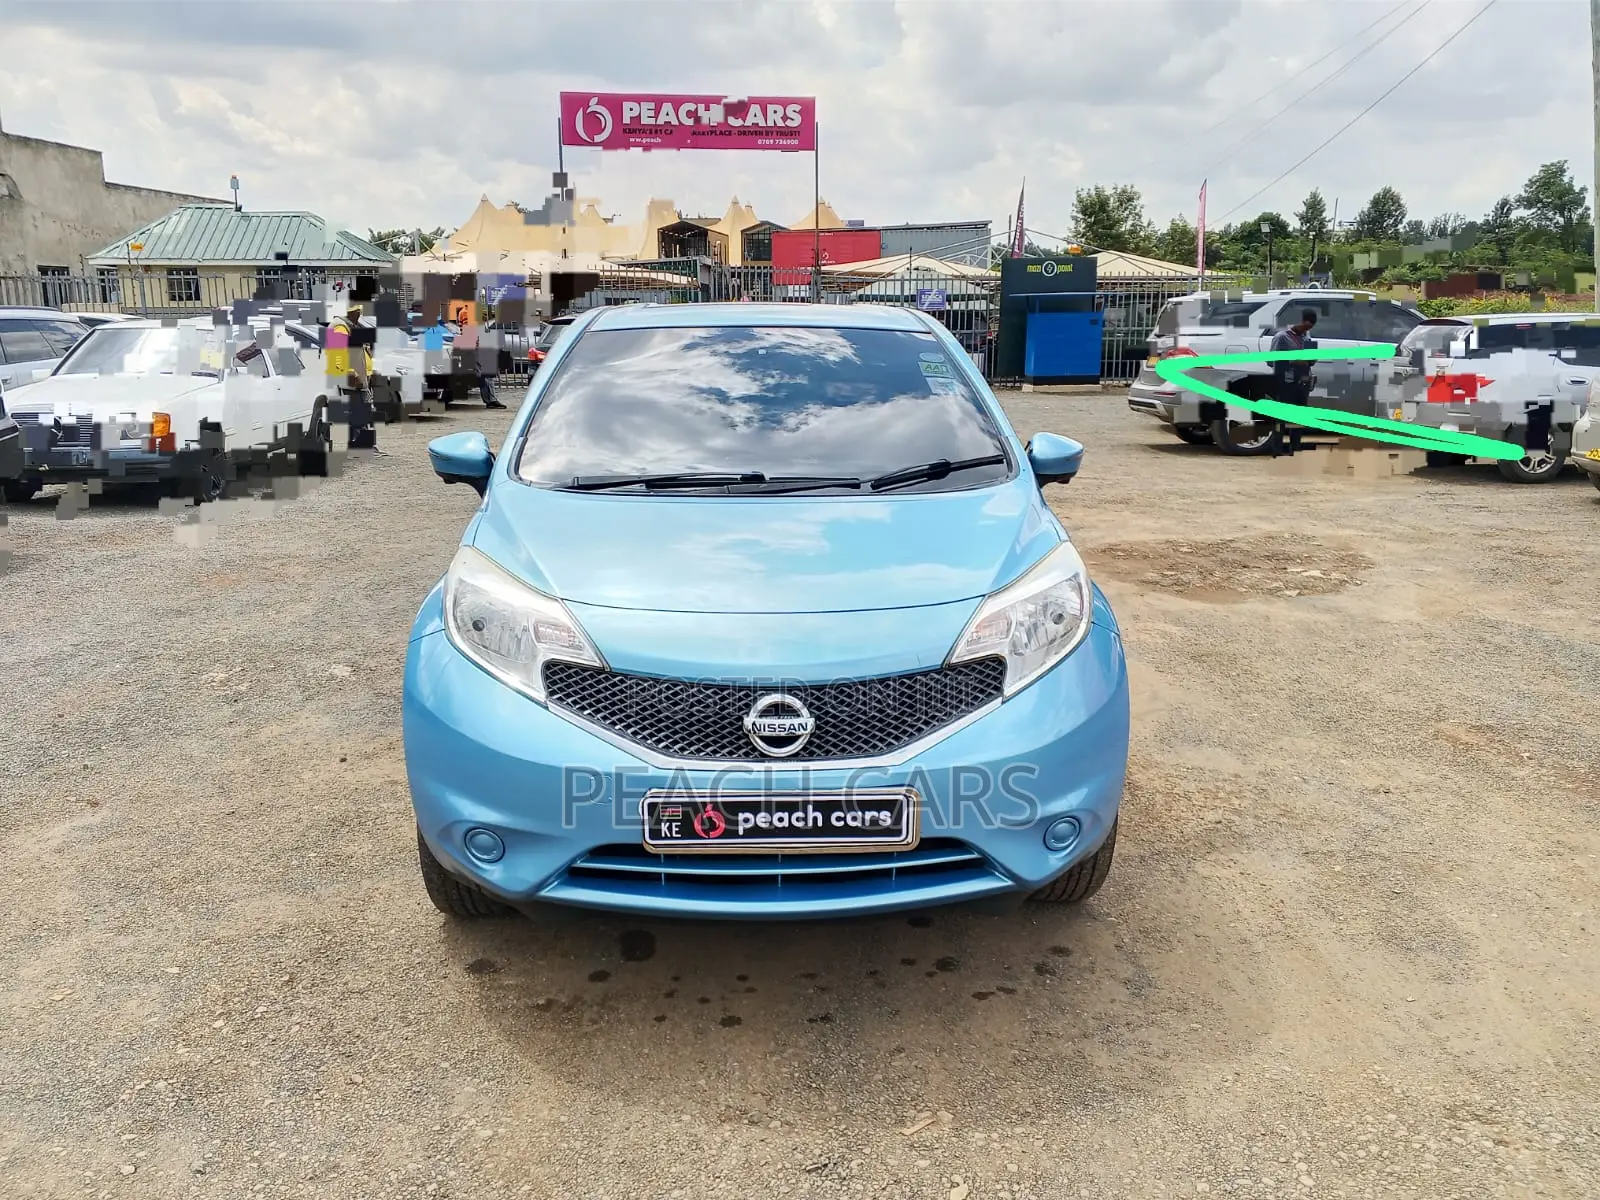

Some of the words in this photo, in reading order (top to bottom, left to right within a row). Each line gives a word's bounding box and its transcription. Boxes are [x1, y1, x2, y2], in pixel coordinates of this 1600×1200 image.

[622, 101, 718, 126] PEACH
[751, 721, 808, 733] NISSAN
[661, 822, 682, 838] KE
[738, 804, 823, 835] peach
[830, 809, 893, 827] cars
